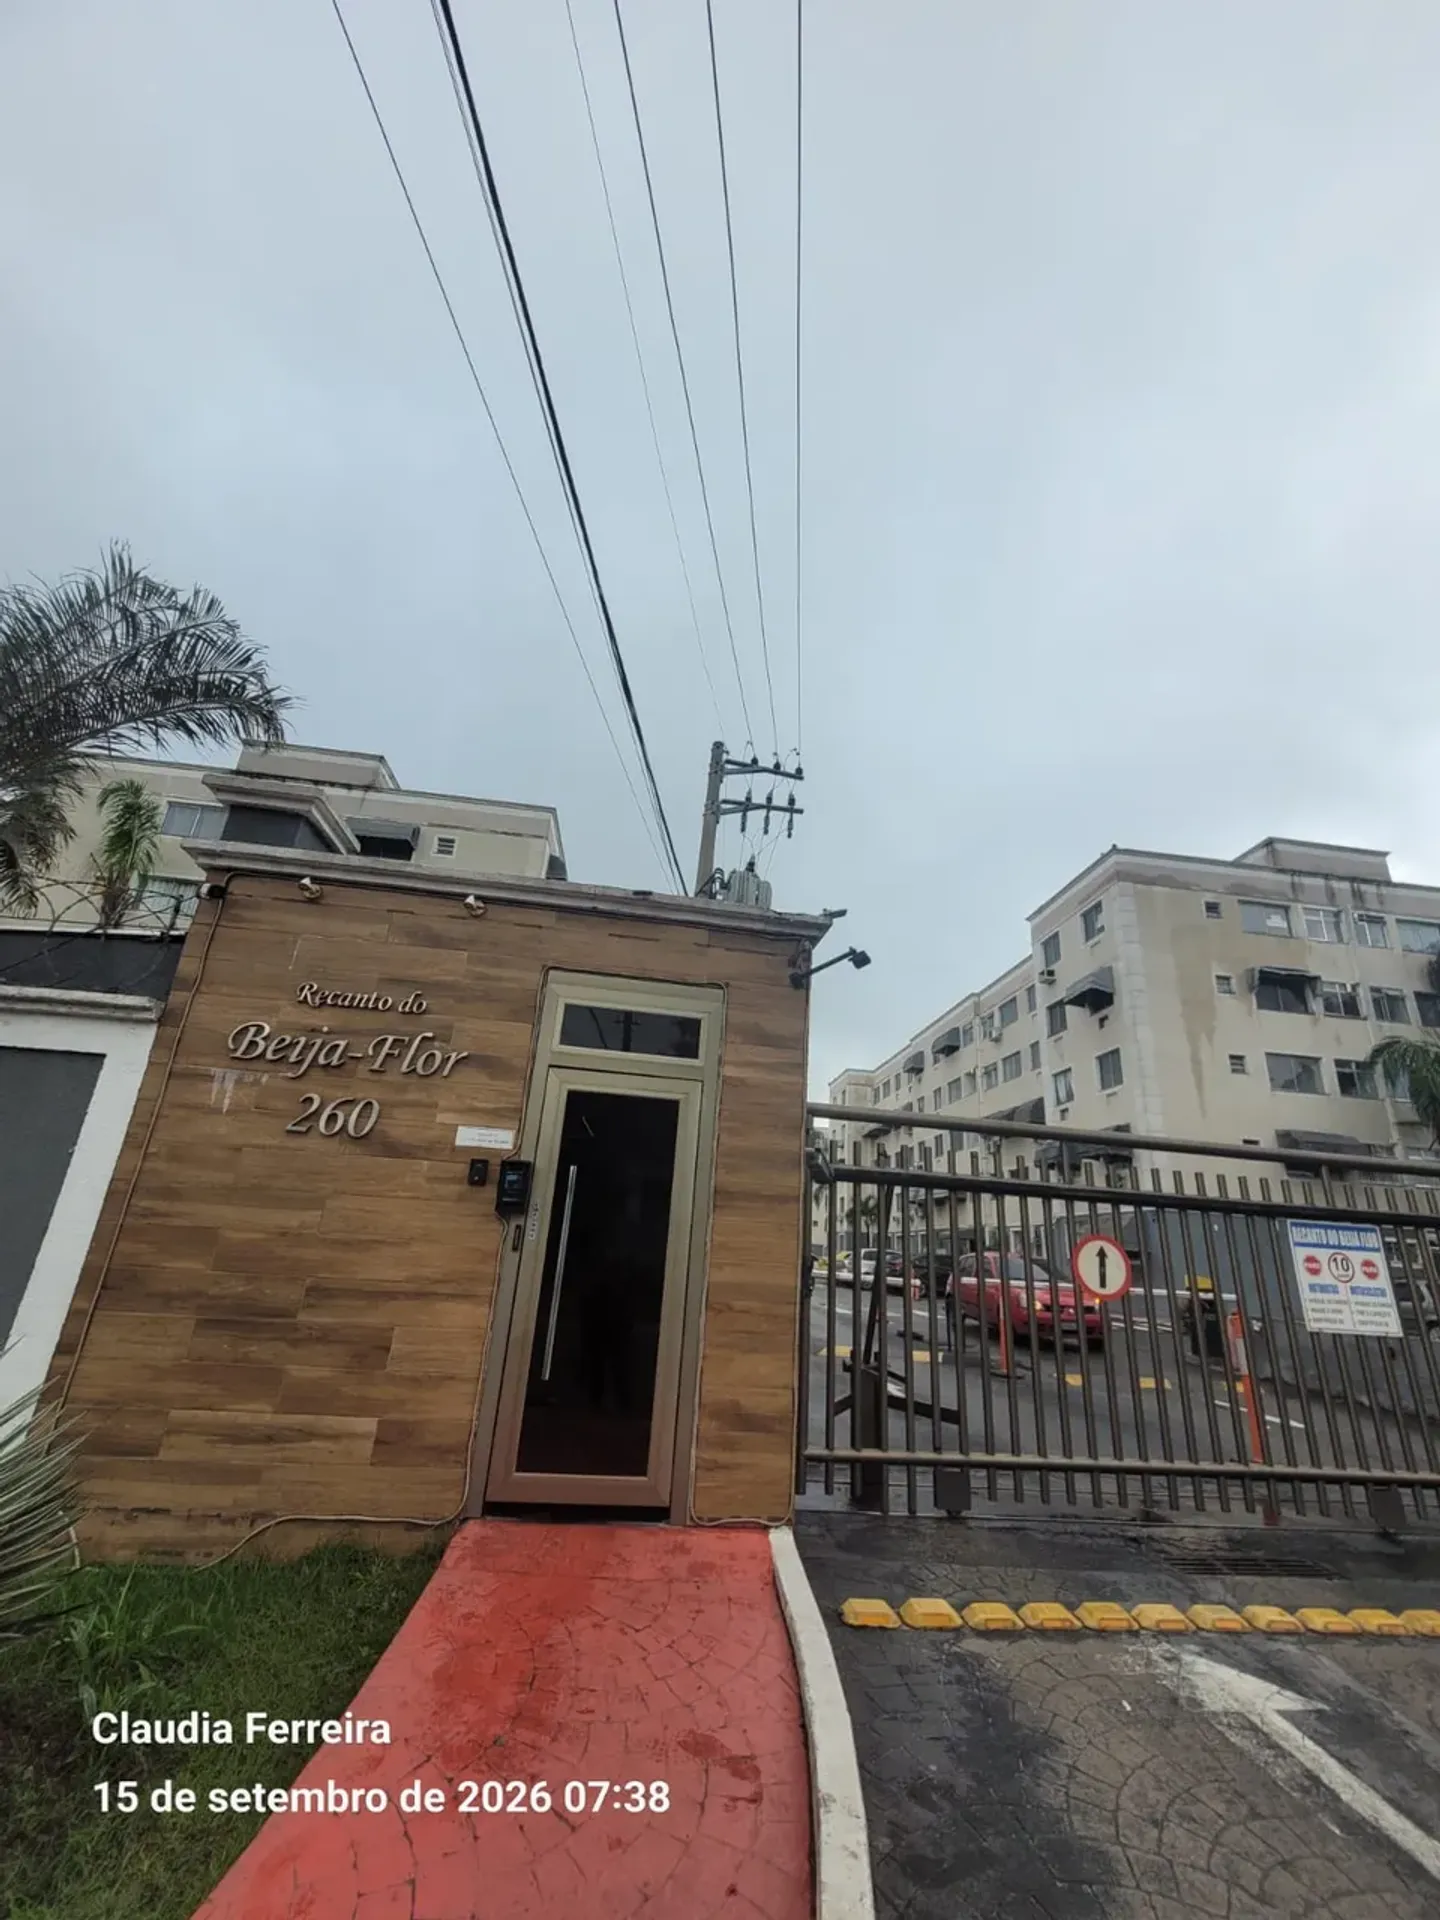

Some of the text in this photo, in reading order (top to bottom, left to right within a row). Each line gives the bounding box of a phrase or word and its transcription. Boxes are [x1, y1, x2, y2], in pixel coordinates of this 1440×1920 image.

[297, 981, 427, 1014] Recanto do
[228, 1021, 469, 1078] Beija-Flor
[285, 1093, 380, 1138] 260
[1332, 1256, 1350, 1272] 10
